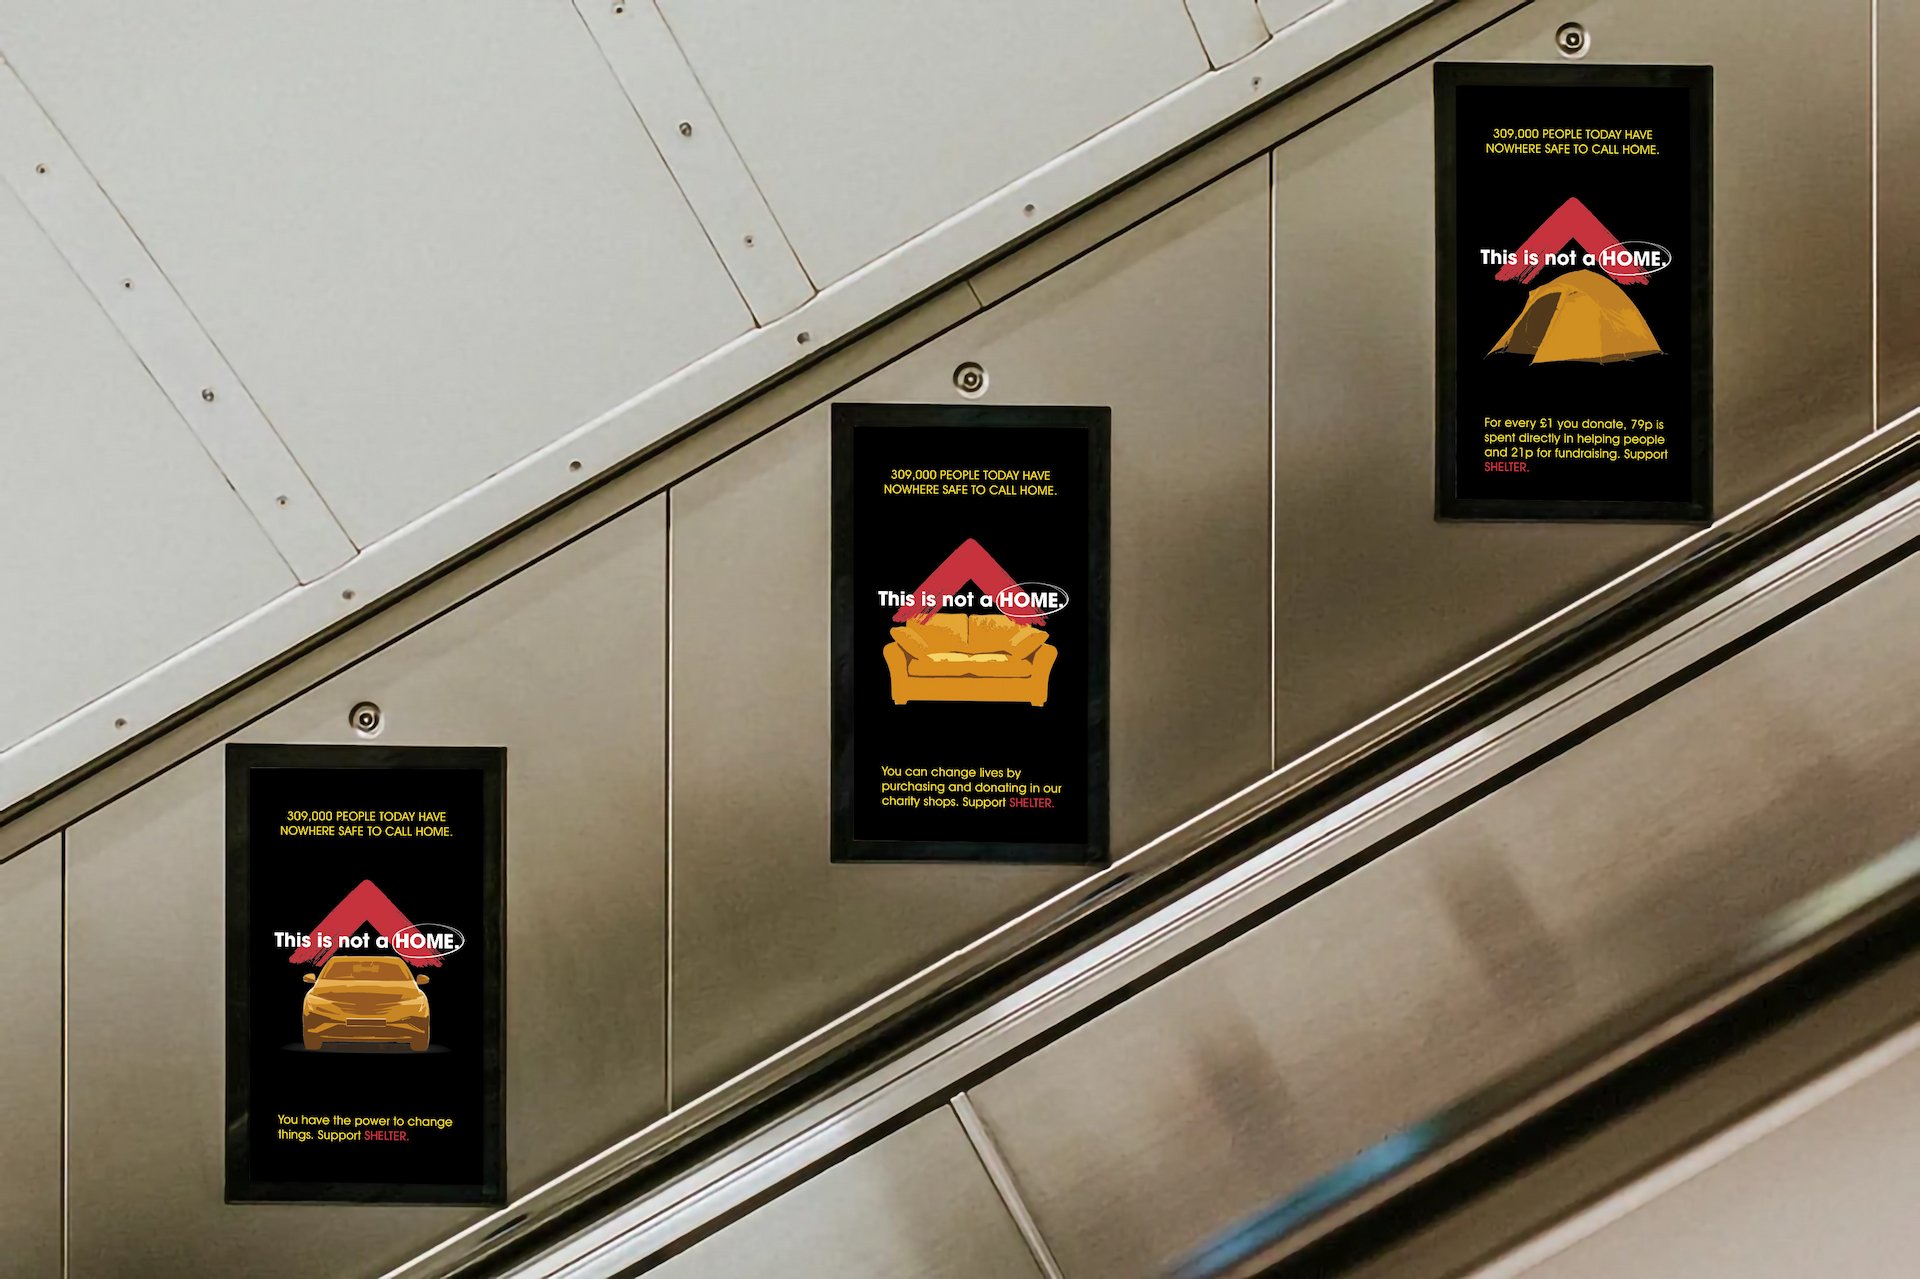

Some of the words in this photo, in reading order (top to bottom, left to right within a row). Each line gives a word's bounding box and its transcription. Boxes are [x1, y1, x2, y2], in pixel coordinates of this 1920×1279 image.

[1493, 128, 1539, 140] 309,000
[1542, 129, 1582, 139] PEOPLE
[1585, 129, 1622, 139] TODAY
[1625, 130, 1653, 140] HAVE
[1486, 143, 1541, 154] NOWHERE
[1545, 143, 1570, 154] SAFE
[1573, 143, 1589, 154] TO
[1591, 144, 1619, 155] CALL
[1622, 144, 1659, 155] HOME.
[1480, 249, 1518, 265] This
[1524, 249, 1539, 266] is
[1545, 250, 1577, 266] not
[1582, 253, 1596, 267] a
[1602, 249, 1667, 267] HOME.
[1484, 417, 1502, 427] For
[1504, 419, 1536, 430] every
[1540, 418, 1552, 428] £1
[1557, 420, 1578, 430] you
[1581, 419, 1626, 430] donate,
[1631, 419, 1653, 432] 79p
[1656, 420, 1664, 430] is
[1484, 433, 1516, 444] spent
[1519, 433, 1561, 445] directly
[1564, 433, 1574, 443] in
[1577, 433, 1620, 446] helping
[1624, 434, 1665, 446] people
[1484, 447, 1508, 457] and
[1511, 447, 1534, 459] 21p
[1536, 447, 1552, 458] for
[1555, 448, 1620, 461] fundraising.
[1624, 448, 1668, 461] Support
[1485, 462, 1529, 472] SHELTER.
[891, 469, 937, 481] 309,000
[940, 470, 980, 480] PEOPLE
[983, 470, 1020, 480] TODAY
[1023, 470, 1050, 481] HAVE
[884, 484, 939, 495] NOWHERE
[942, 484, 968, 495] SAFE
[971, 485, 986, 495] TO
[989, 485, 1017, 495] CALL
[1020, 485, 1057, 496] HOME.
[878, 591, 915, 607] This
[922, 591, 936, 607] is
[942, 592, 974, 607] not
[979, 594, 993, 608] a
[999, 591, 1064, 609] HOME.
[881, 766, 902, 776] You
[905, 768, 928, 777] can
[931, 767, 977, 780] change
[980, 767, 1004, 778] lives
[1007, 768, 1021, 780] by
[882, 781, 945, 794] purchasing
[948, 782, 972, 792] and
[974, 782, 1027, 795] donating
[1030, 783, 1040, 793] in
[1043, 785, 1062, 794] our
[882, 796, 920, 808] charity
[923, 796, 959, 808] shops.
[962, 796, 1006, 809] Support
[1009, 797, 1054, 808] SHELTER.
[287, 810, 333, 822] 309,000
[336, 811, 376, 821] PEOPLE
[379, 811, 415, 822] TODAY
[418, 812, 446, 822] HAVE
[280, 825, 335, 836] NOWHERE
[338, 825, 363, 836] SAFE
[367, 826, 382, 836] TO
[385, 826, 412, 836] CALL
[416, 826, 453, 837] HOME.
[274, 932, 311, 948] This
[317, 932, 332, 948] is
[339, 933, 370, 948] not
[375, 935, 389, 949] a
[395, 932, 460, 950] HOME.
[278, 1114, 298, 1125] You
[301, 1115, 330, 1125] have
[333, 1115, 352, 1125] the
[355, 1117, 390, 1127] power
[393, 1116, 405, 1126] to
[407, 1116, 453, 1129] change
[278, 1129, 313, 1142] things.
[317, 1129, 361, 1142] Support
[364, 1130, 409, 1141] SHELTER.
